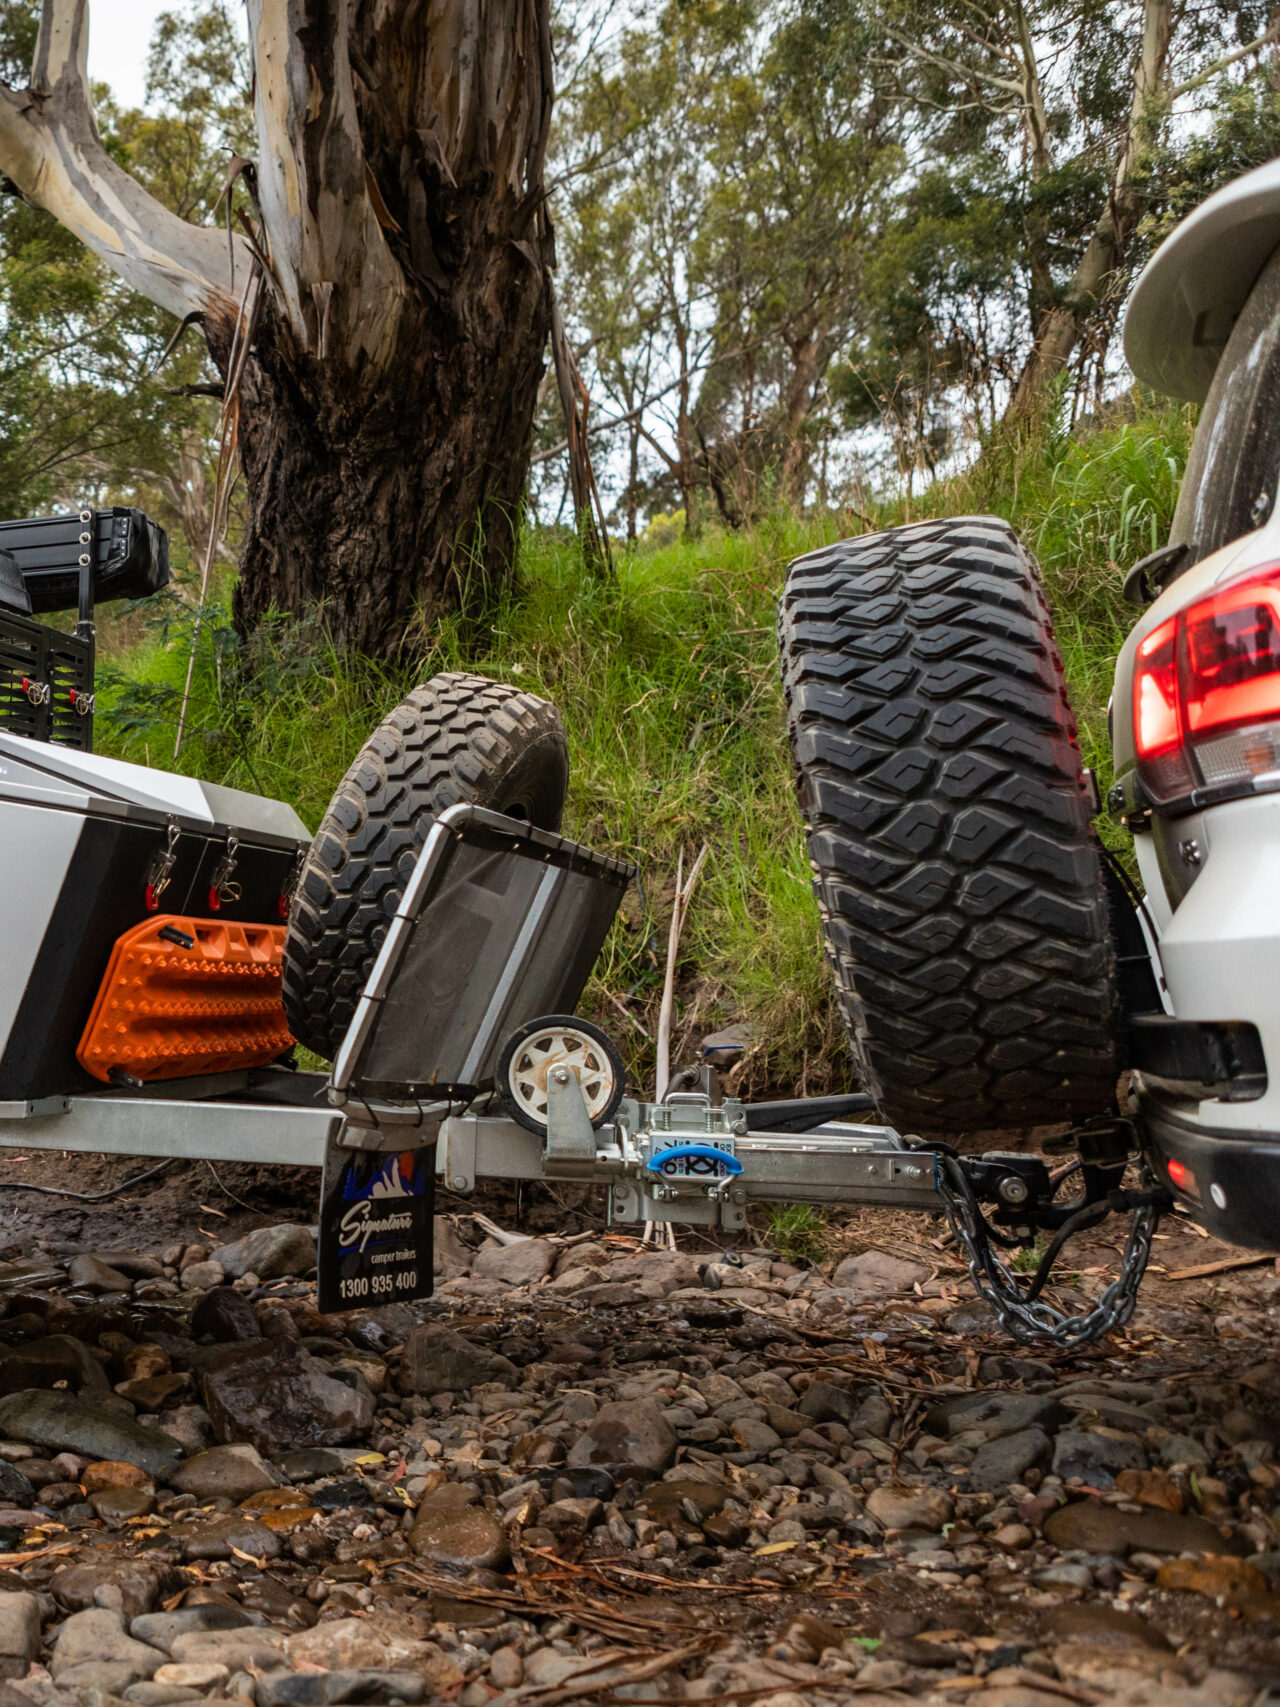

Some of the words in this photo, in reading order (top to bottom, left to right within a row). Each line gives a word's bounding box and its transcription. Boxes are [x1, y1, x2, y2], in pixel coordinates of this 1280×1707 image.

[339, 1200, 413, 1253] Signature
[371, 1252, 395, 1264] camper
[395, 1249, 417, 1261] trailers
[340, 1277, 368, 1298] 1300
[372, 1275, 393, 1294] 935
[395, 1271, 417, 1289] 400
